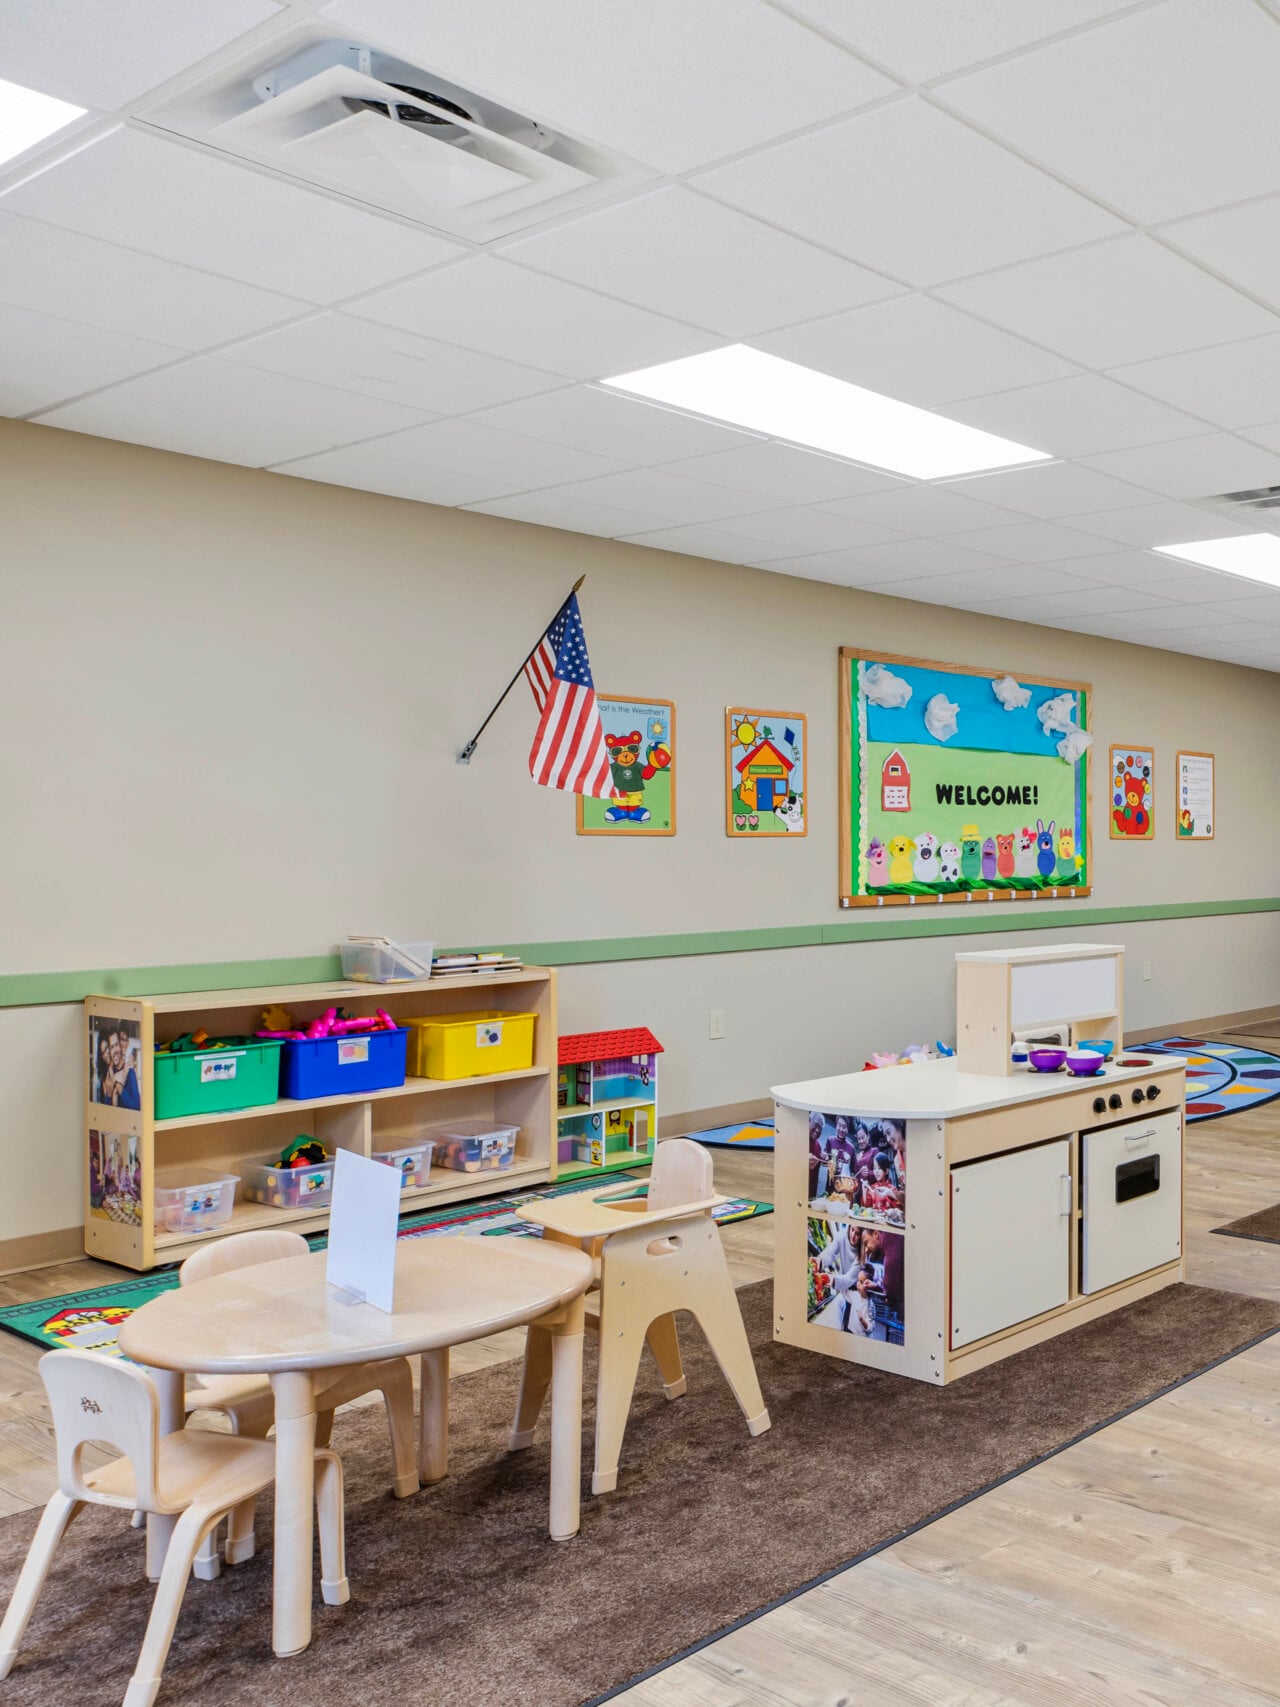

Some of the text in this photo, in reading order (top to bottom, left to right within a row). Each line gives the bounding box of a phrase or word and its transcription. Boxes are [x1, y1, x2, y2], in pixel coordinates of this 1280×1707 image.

[618, 706, 630, 714] the
[632, 707, 665, 716] Weather?
[936, 783, 1039, 806] WELCOME!
